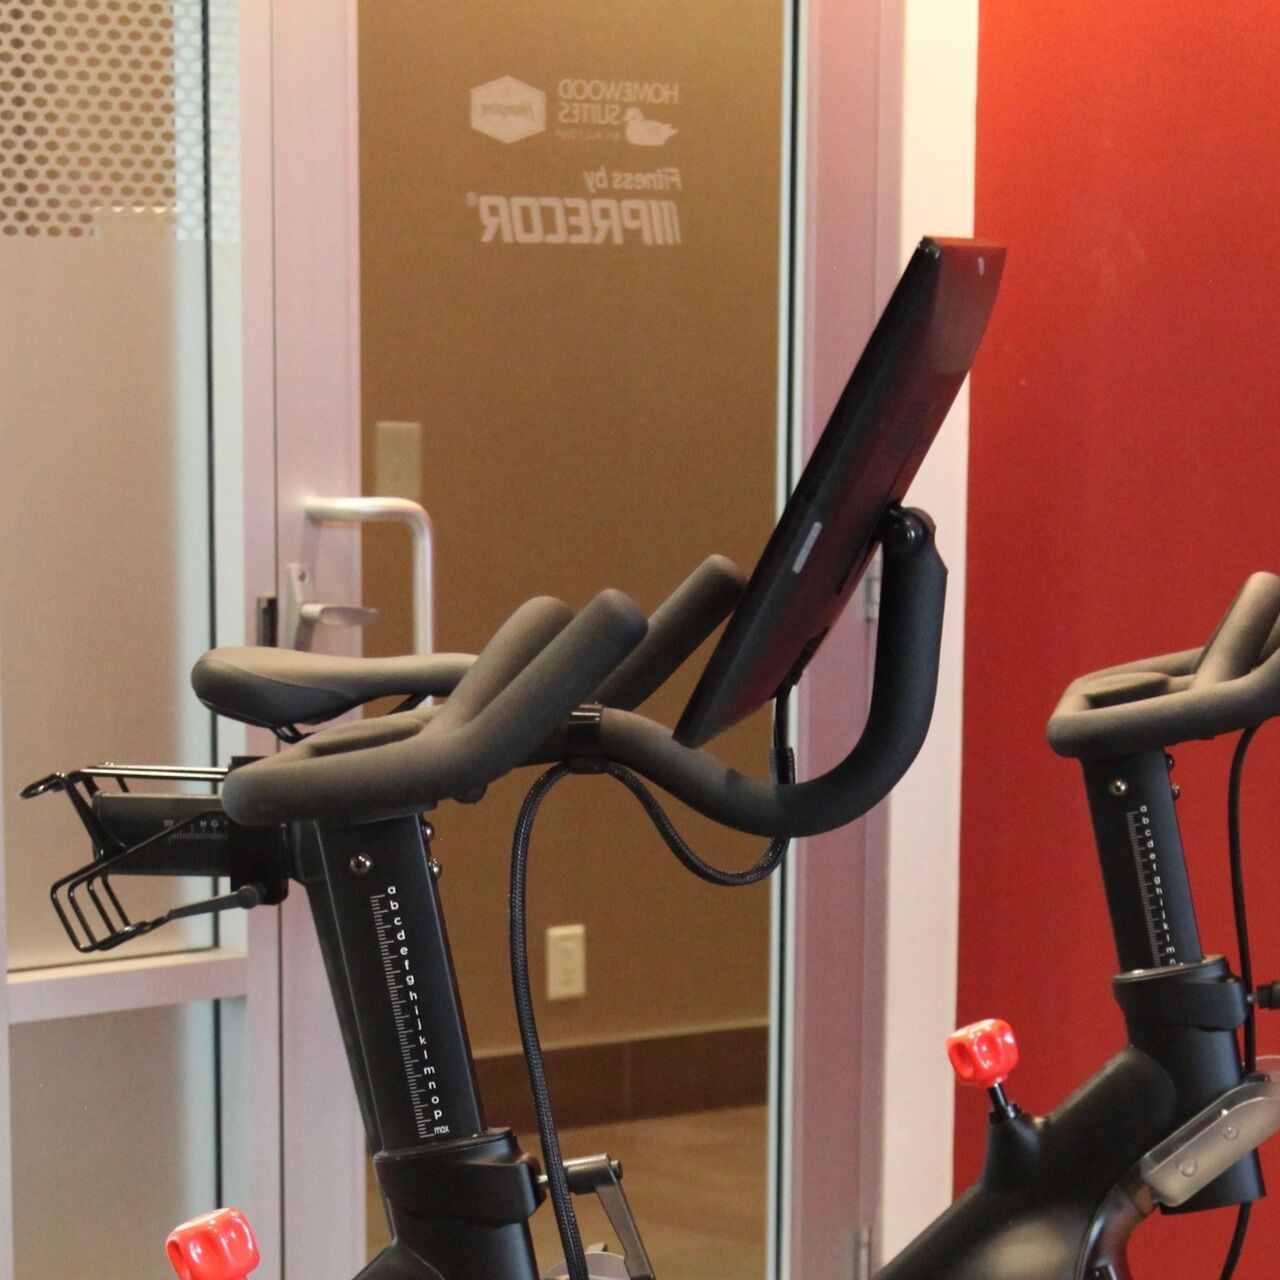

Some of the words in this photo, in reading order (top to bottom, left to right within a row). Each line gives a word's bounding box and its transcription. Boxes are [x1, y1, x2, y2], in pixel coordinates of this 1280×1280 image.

[388, 886, 396, 895] a
[390, 900, 399, 910] b
[394, 916, 402, 926] c
[396, 930, 406, 941] d
[400, 946, 408, 956] e
[406, 975, 414, 986] g
[409, 990, 418, 1001] h
[419, 1036, 426, 1045] k
[424, 1066, 435, 1075] m
[428, 1080, 436, 1090] n
[432, 1096, 440, 1104] o
[434, 1110, 442, 1120] p
[434, 1124, 450, 1134] max
